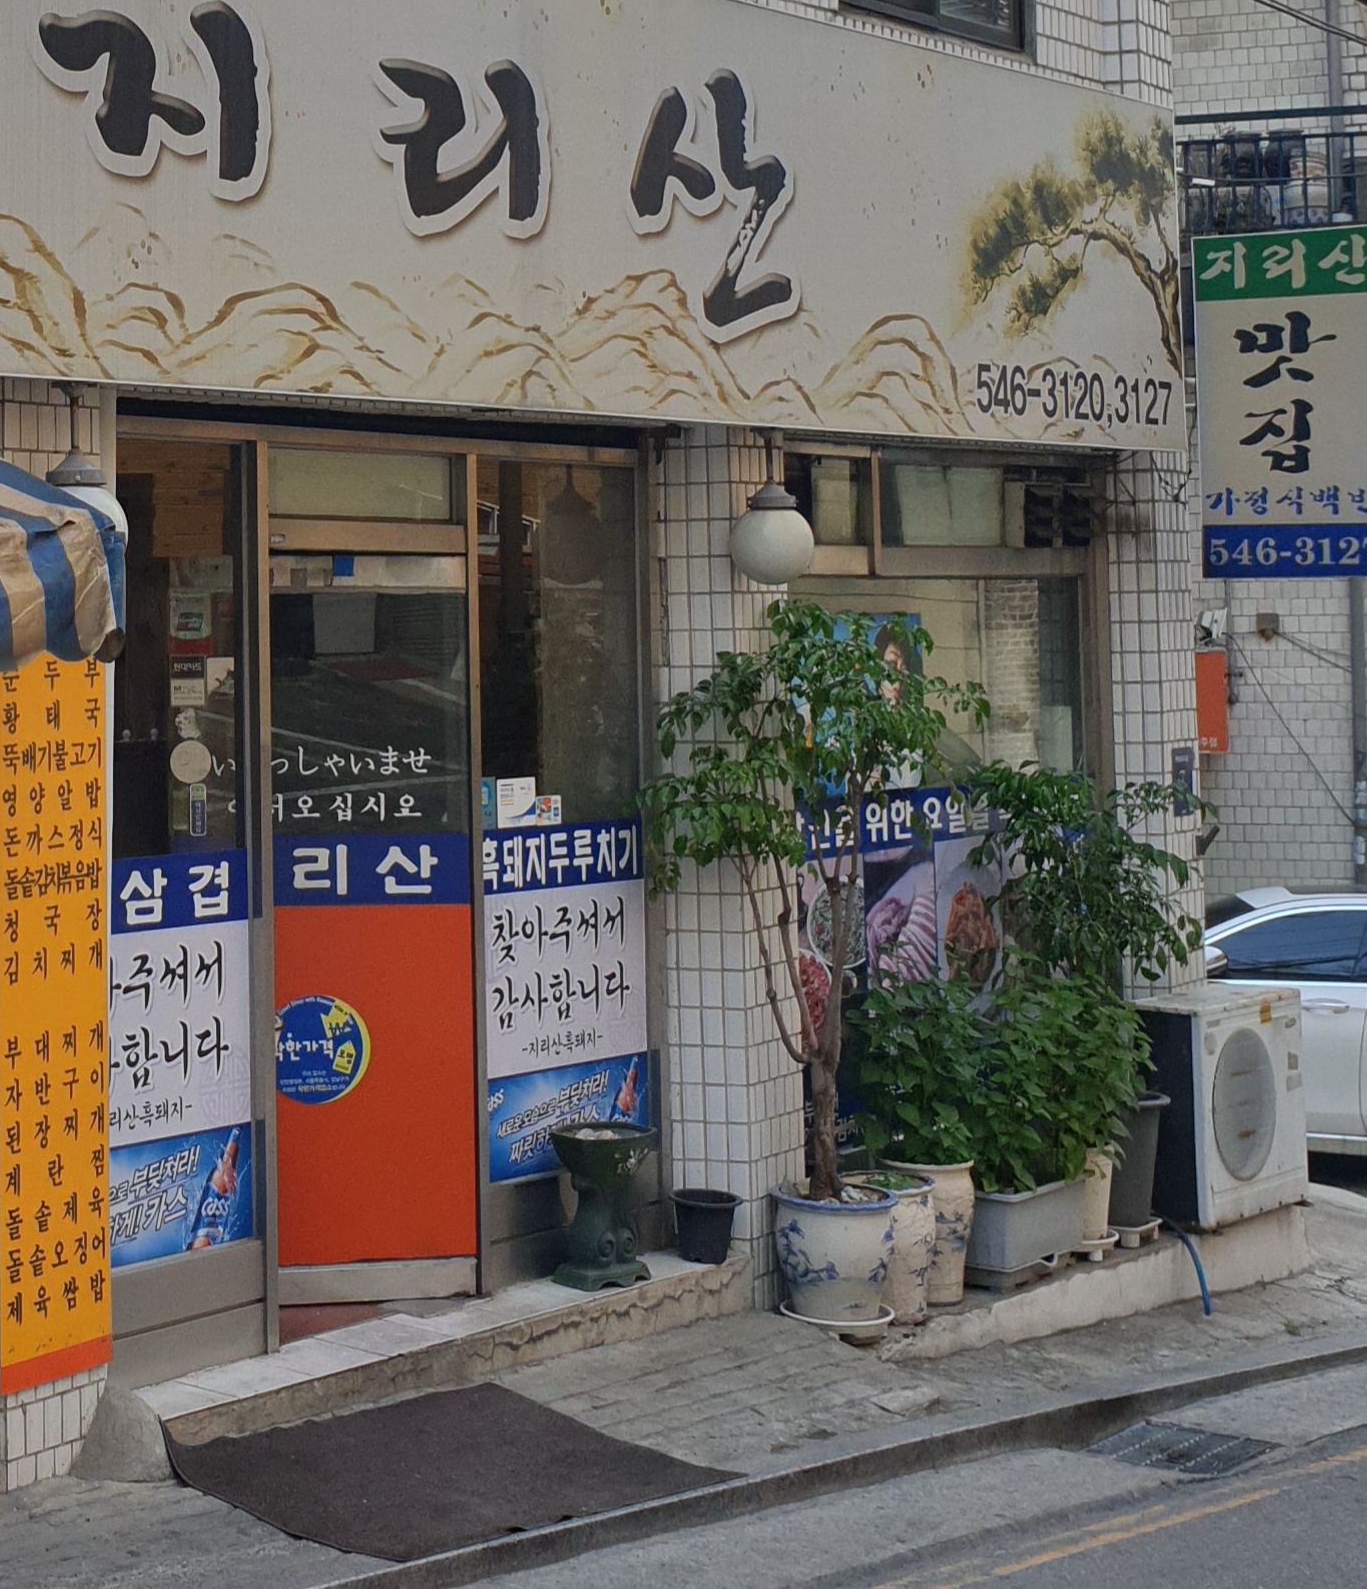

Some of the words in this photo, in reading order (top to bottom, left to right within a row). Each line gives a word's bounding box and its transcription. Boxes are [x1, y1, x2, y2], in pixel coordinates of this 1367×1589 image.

[975, 362, 1173, 429] 546-3120,3127
[1209, 536, 1367, 567] 546-312
[2, 697, 101, 735] 황태국
[2, 736, 102, 777] 뚝배기불고기
[2, 777, 102, 817] 영양알밥
[865, 799, 914, 843] 위한
[3, 817, 103, 858] 돈까스정식
[483, 825, 638, 892] 흑돼지두루치기
[4, 858, 102, 901] 돌솥김치볶음밥
[4, 898, 102, 943] 청국장
[491, 895, 625, 965] 찾아주셔서
[4, 938, 102, 986] 김치찌개
[491, 959, 631, 1032] 감사합니다
[4, 1020, 103, 1070] 부대찌개
[4, 1060, 103, 1113] 자반구이
[5, 1101, 104, 1155] 된장찌개
[5, 1143, 104, 1197] 계란찜
[5, 1185, 105, 1242] 돌솥제육
[143, 1185, 187, 1230] 카스
[6, 1226, 106, 1284] 돌솥오징어
[6, 1268, 106, 1326] 제육쌈밥
